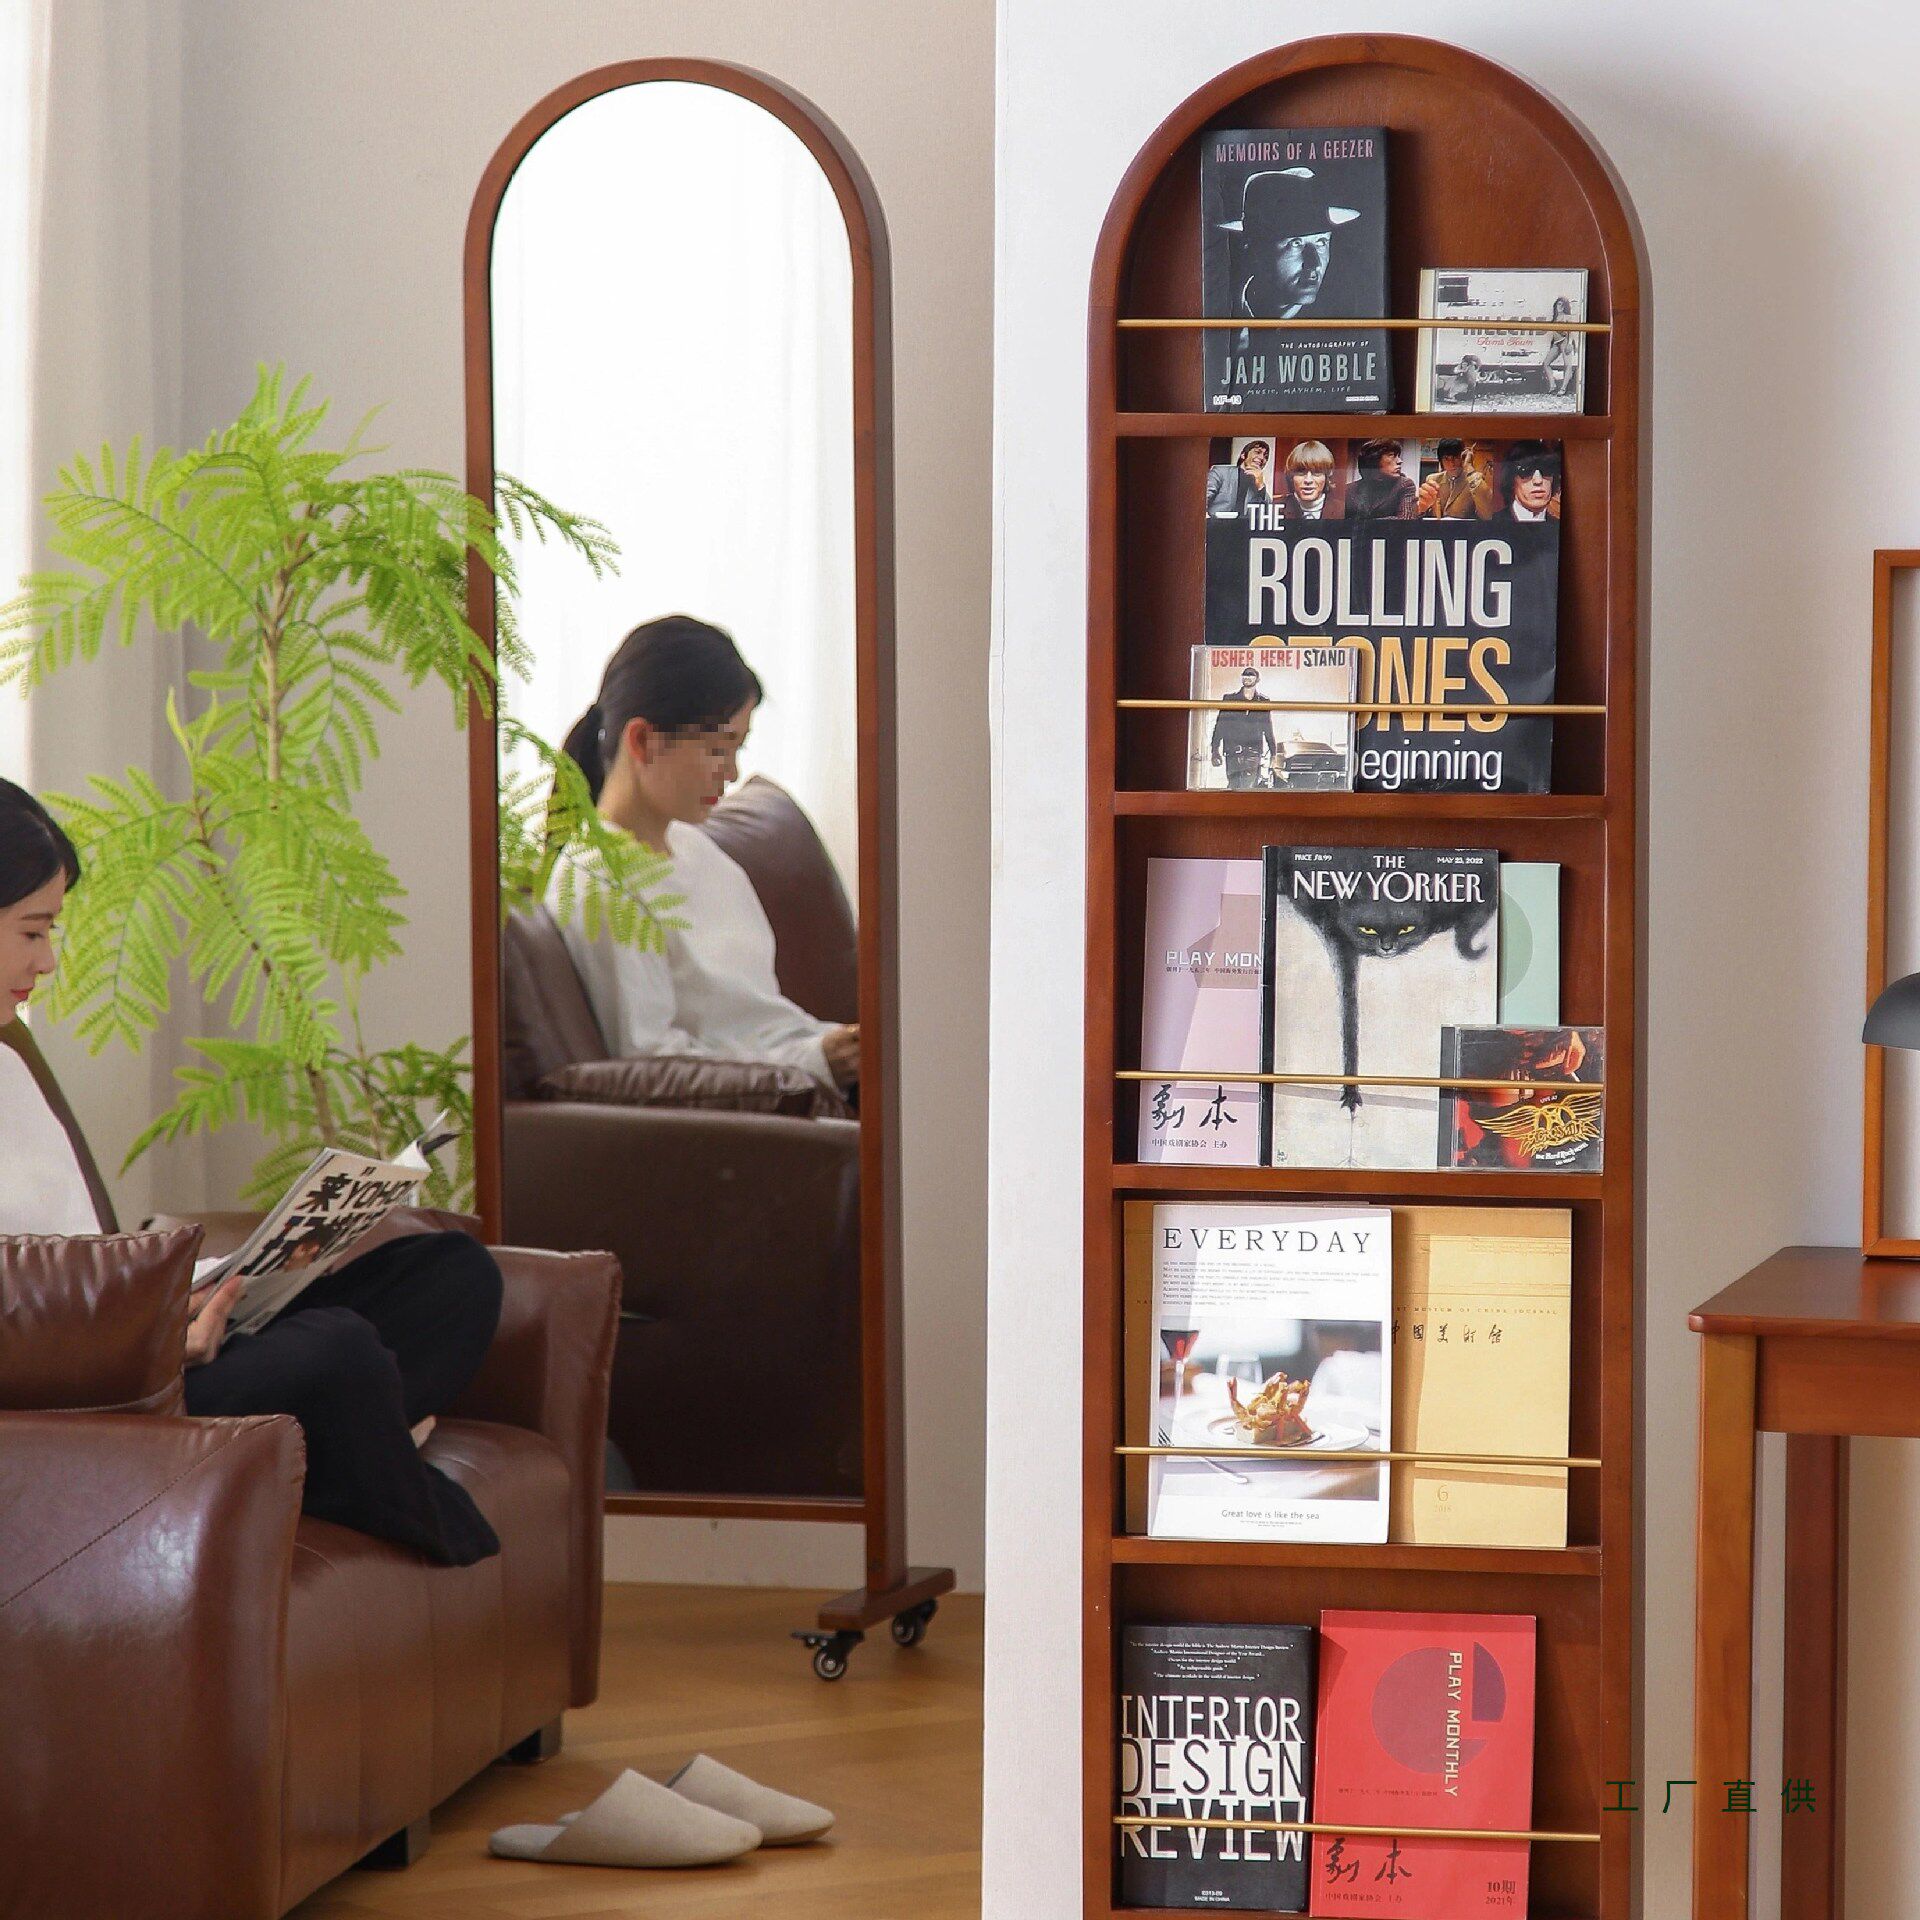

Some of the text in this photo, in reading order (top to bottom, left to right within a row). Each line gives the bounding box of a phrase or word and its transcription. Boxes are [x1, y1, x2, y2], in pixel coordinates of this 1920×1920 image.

[1216, 139, 1374, 163] MEMOIRS OF A GEEZER
[1221, 352, 1377, 385] JAH WOBBLE
[1247, 503, 1285, 531] THE
[1248, 538, 1514, 627] ROLLING
[1210, 649, 1254, 668] USHER
[1260, 649, 1293, 668] HERE
[1303, 649, 1346, 668] STAND
[1353, 738, 1503, 790] eginning
[1373, 855, 1406, 869] THE
[1294, 870, 1485, 903] NEW YORKER
[1166, 950, 1215, 966] PLAY
[1163, 1228, 1371, 1253] EVERYDAY
[1221, 1509, 1243, 1518] Great
[1246, 1510, 1262, 1518] love
[1274, 1510, 1288, 1519] like
[1290, 1511, 1303, 1519] the
[1122, 1695, 1306, 1743] INTERIOR
[1444, 1651, 1462, 1797] PLAY MONTHLY
[1122, 1739, 1307, 1798] DESIGN
[1122, 1797, 1306, 1861] REVIEW
[1487, 1880, 1516, 1894] 10期
